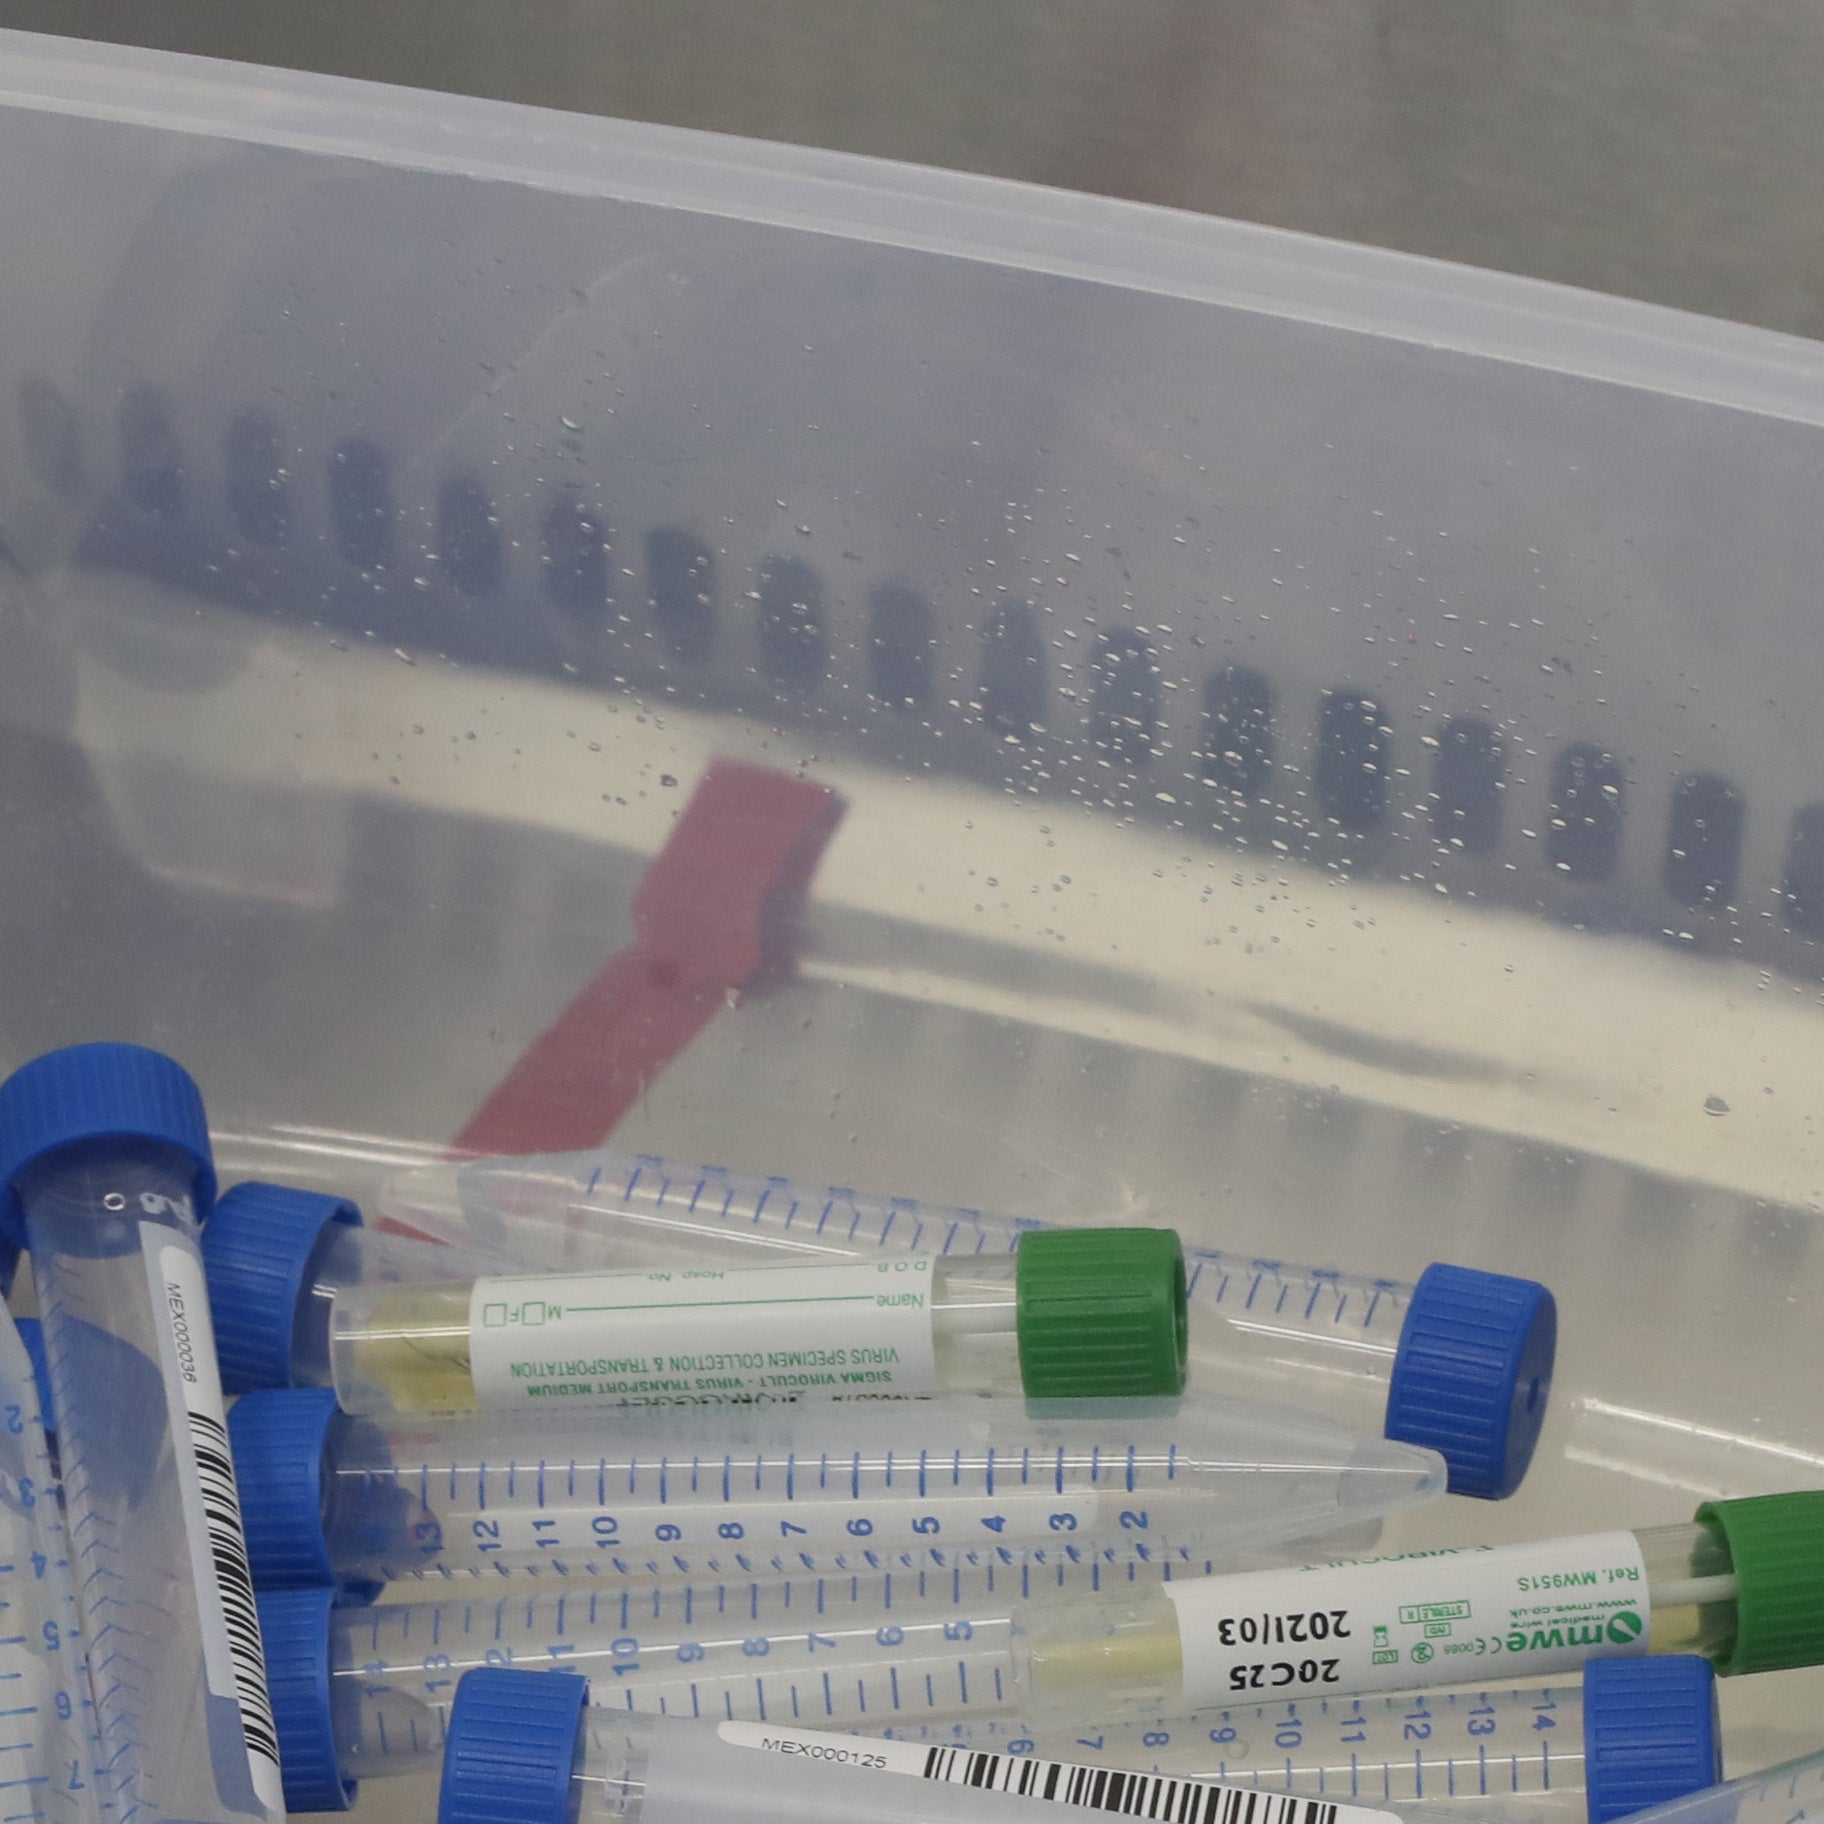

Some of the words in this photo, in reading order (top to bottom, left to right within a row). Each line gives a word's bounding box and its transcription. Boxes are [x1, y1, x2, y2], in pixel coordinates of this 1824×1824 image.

[877, 1292, 924, 1308] Name
[509, 1307, 520, 1322] F
[546, 1305, 562, 1320] M
[166, 1282, 199, 1383] MEX000036
[655, 1357, 665, 1372] &
[670, 1353, 766, 1371] COLLECTION
[774, 1350, 848, 1367] SPECIMEN
[851, 1348, 900, 1364] VIRUS
[510, 1358, 650, 1378] TRANSPORTATION
[841, 1371, 892, 1384] SIGMA
[597, 1379, 688, 1394] TRANSPORT
[692, 1377, 744, 1390] VIRUS
[764, 1373, 836, 1387] VIROCULT
[528, 1383, 592, 1397] MEDIUM
[781, 1520, 807, 1538] 7
[847, 1519, 874, 1536] 6
[912, 1516, 940, 1534] 5
[981, 1515, 1007, 1534] 4
[1049, 1513, 1077, 1532] 3
[1120, 1511, 1148, 1530] 2
[473, 1519, 501, 1552] 12
[532, 1519, 560, 1548] 11
[592, 1516, 620, 1548] 10
[655, 1524, 682, 1542] 9
[718, 1522, 744, 1541] 8
[1517, 1569, 1598, 1592] MW951S
[1601, 1566, 1640, 1582] Ref.
[1217, 1609, 1352, 1646] 2021/03
[1554, 1613, 1605, 1628] medical
[877, 1625, 905, 1647] 6
[944, 1620, 974, 1641] 5
[1507, 1622, 1603, 1652] mwe
[741, 1636, 772, 1657] 8
[808, 1632, 837, 1653] 7
[485, 1646, 513, 1668] 2
[611, 1636, 641, 1676] 10
[677, 1643, 706, 1663] 9
[424, 1653, 452, 1693] 13
[1229, 1657, 1341, 1692] 20C25
[1467, 1704, 1496, 1738] 13
[1532, 1698, 1558, 1732] 14
[1209, 1724, 1237, 1745] 9
[1275, 1717, 1303, 1750] 10
[1341, 1714, 1366, 1744] 11
[1403, 1710, 1432, 1741] 12
[1007, 1739, 1035, 1755] 6
[1076, 1736, 1103, 1750] 7
[1142, 1732, 1170, 1748] 8
[761, 1736, 888, 1770] MEX000125
